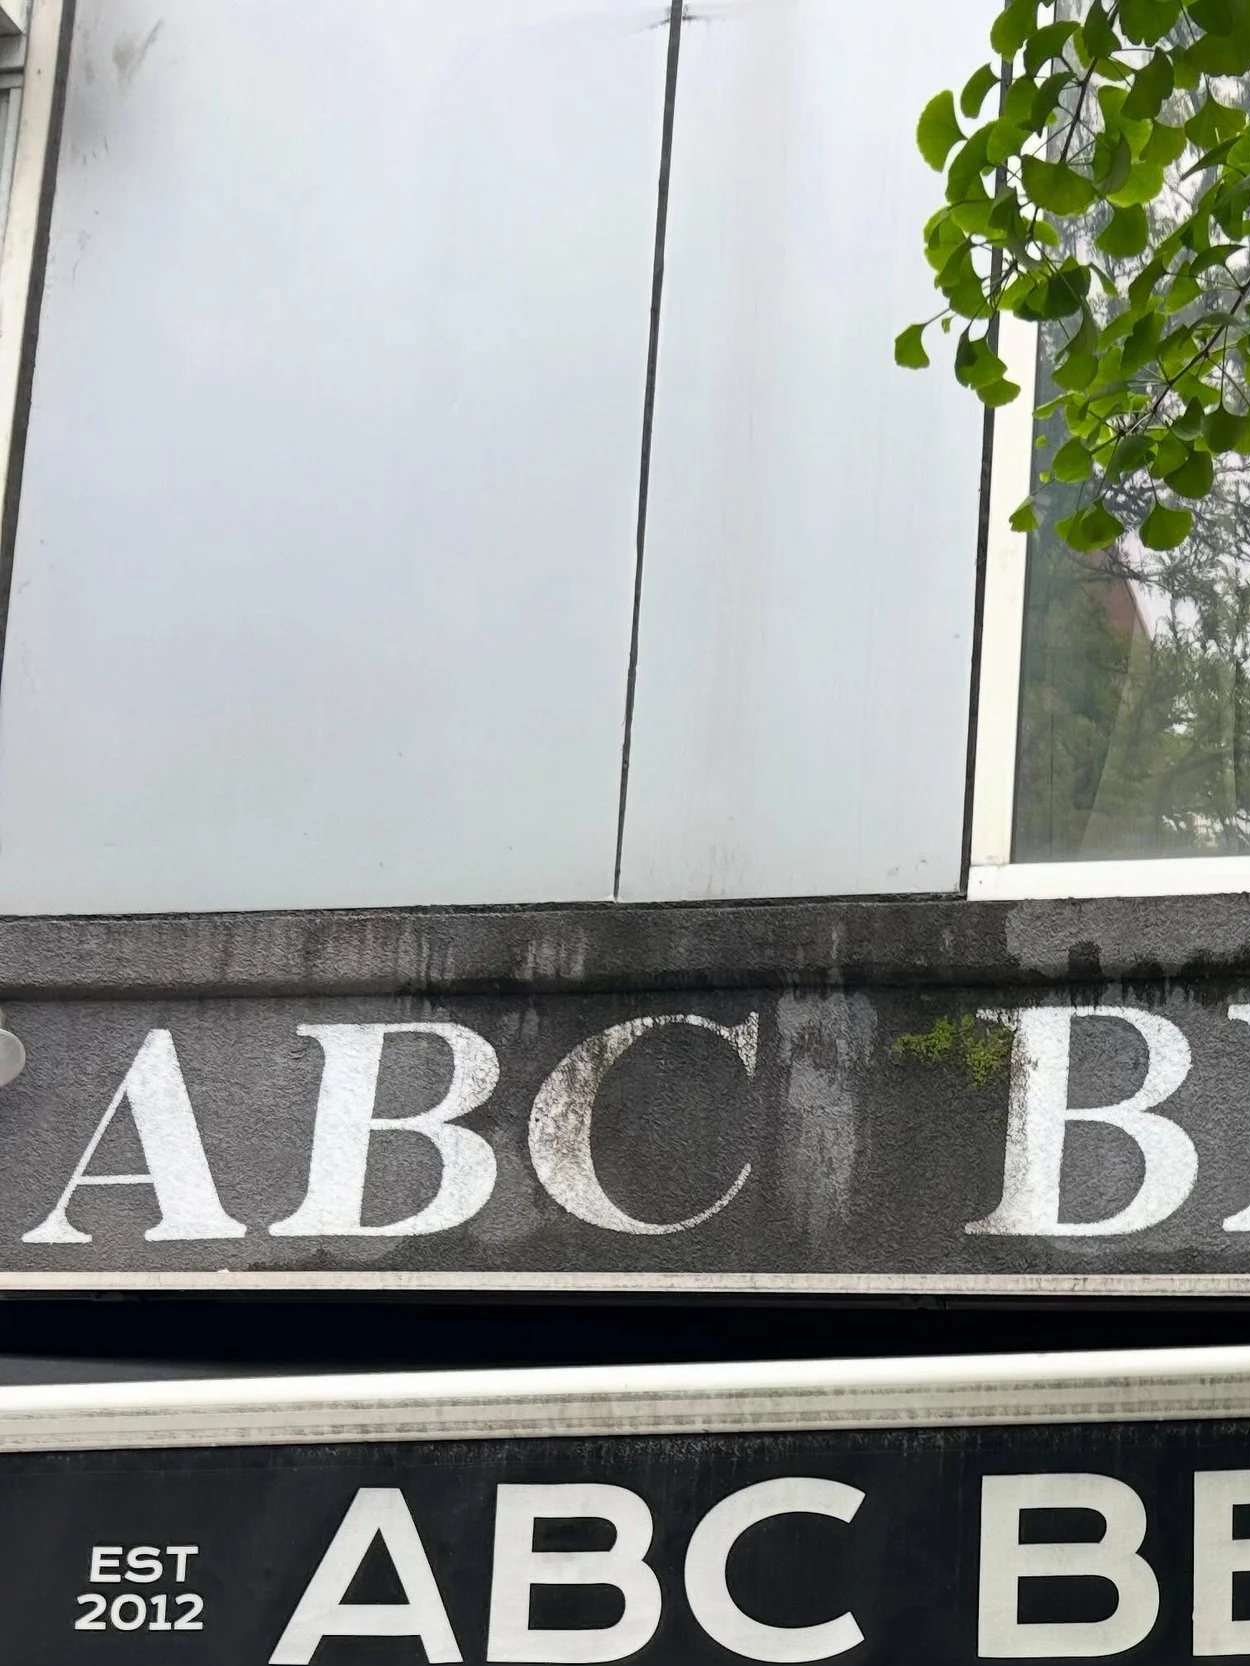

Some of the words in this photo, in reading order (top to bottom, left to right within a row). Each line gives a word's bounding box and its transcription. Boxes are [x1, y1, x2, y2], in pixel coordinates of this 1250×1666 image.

[21, 1012, 759, 1244] ABC
[74, 1591, 205, 1632] 2012
[88, 1545, 200, 1584] EST
[269, 1476, 867, 1666] ABC
